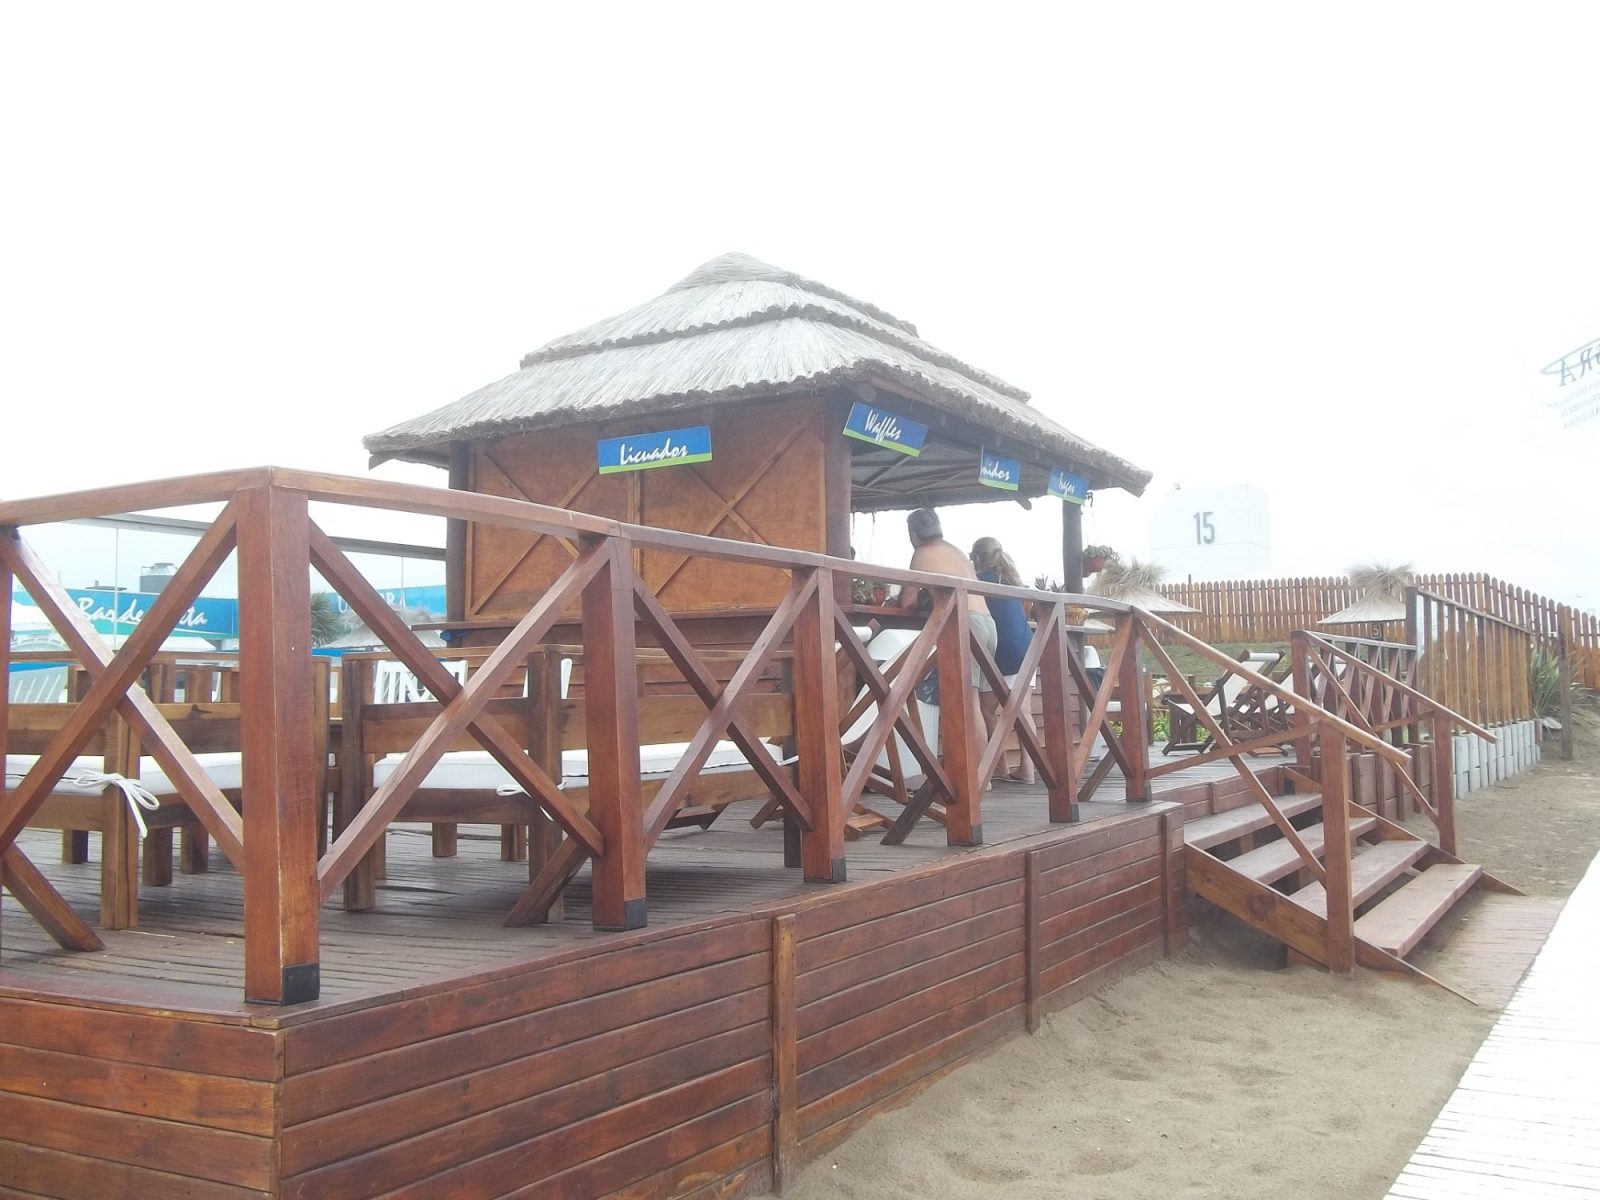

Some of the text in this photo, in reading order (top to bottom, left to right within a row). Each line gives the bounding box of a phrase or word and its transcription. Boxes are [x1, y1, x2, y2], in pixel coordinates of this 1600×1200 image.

[864, 409, 902, 443] Waffles
[620, 437, 688, 465] Licuados
[1193, 511, 1215, 545] 15
[1368, 624, 1379, 636] 5
